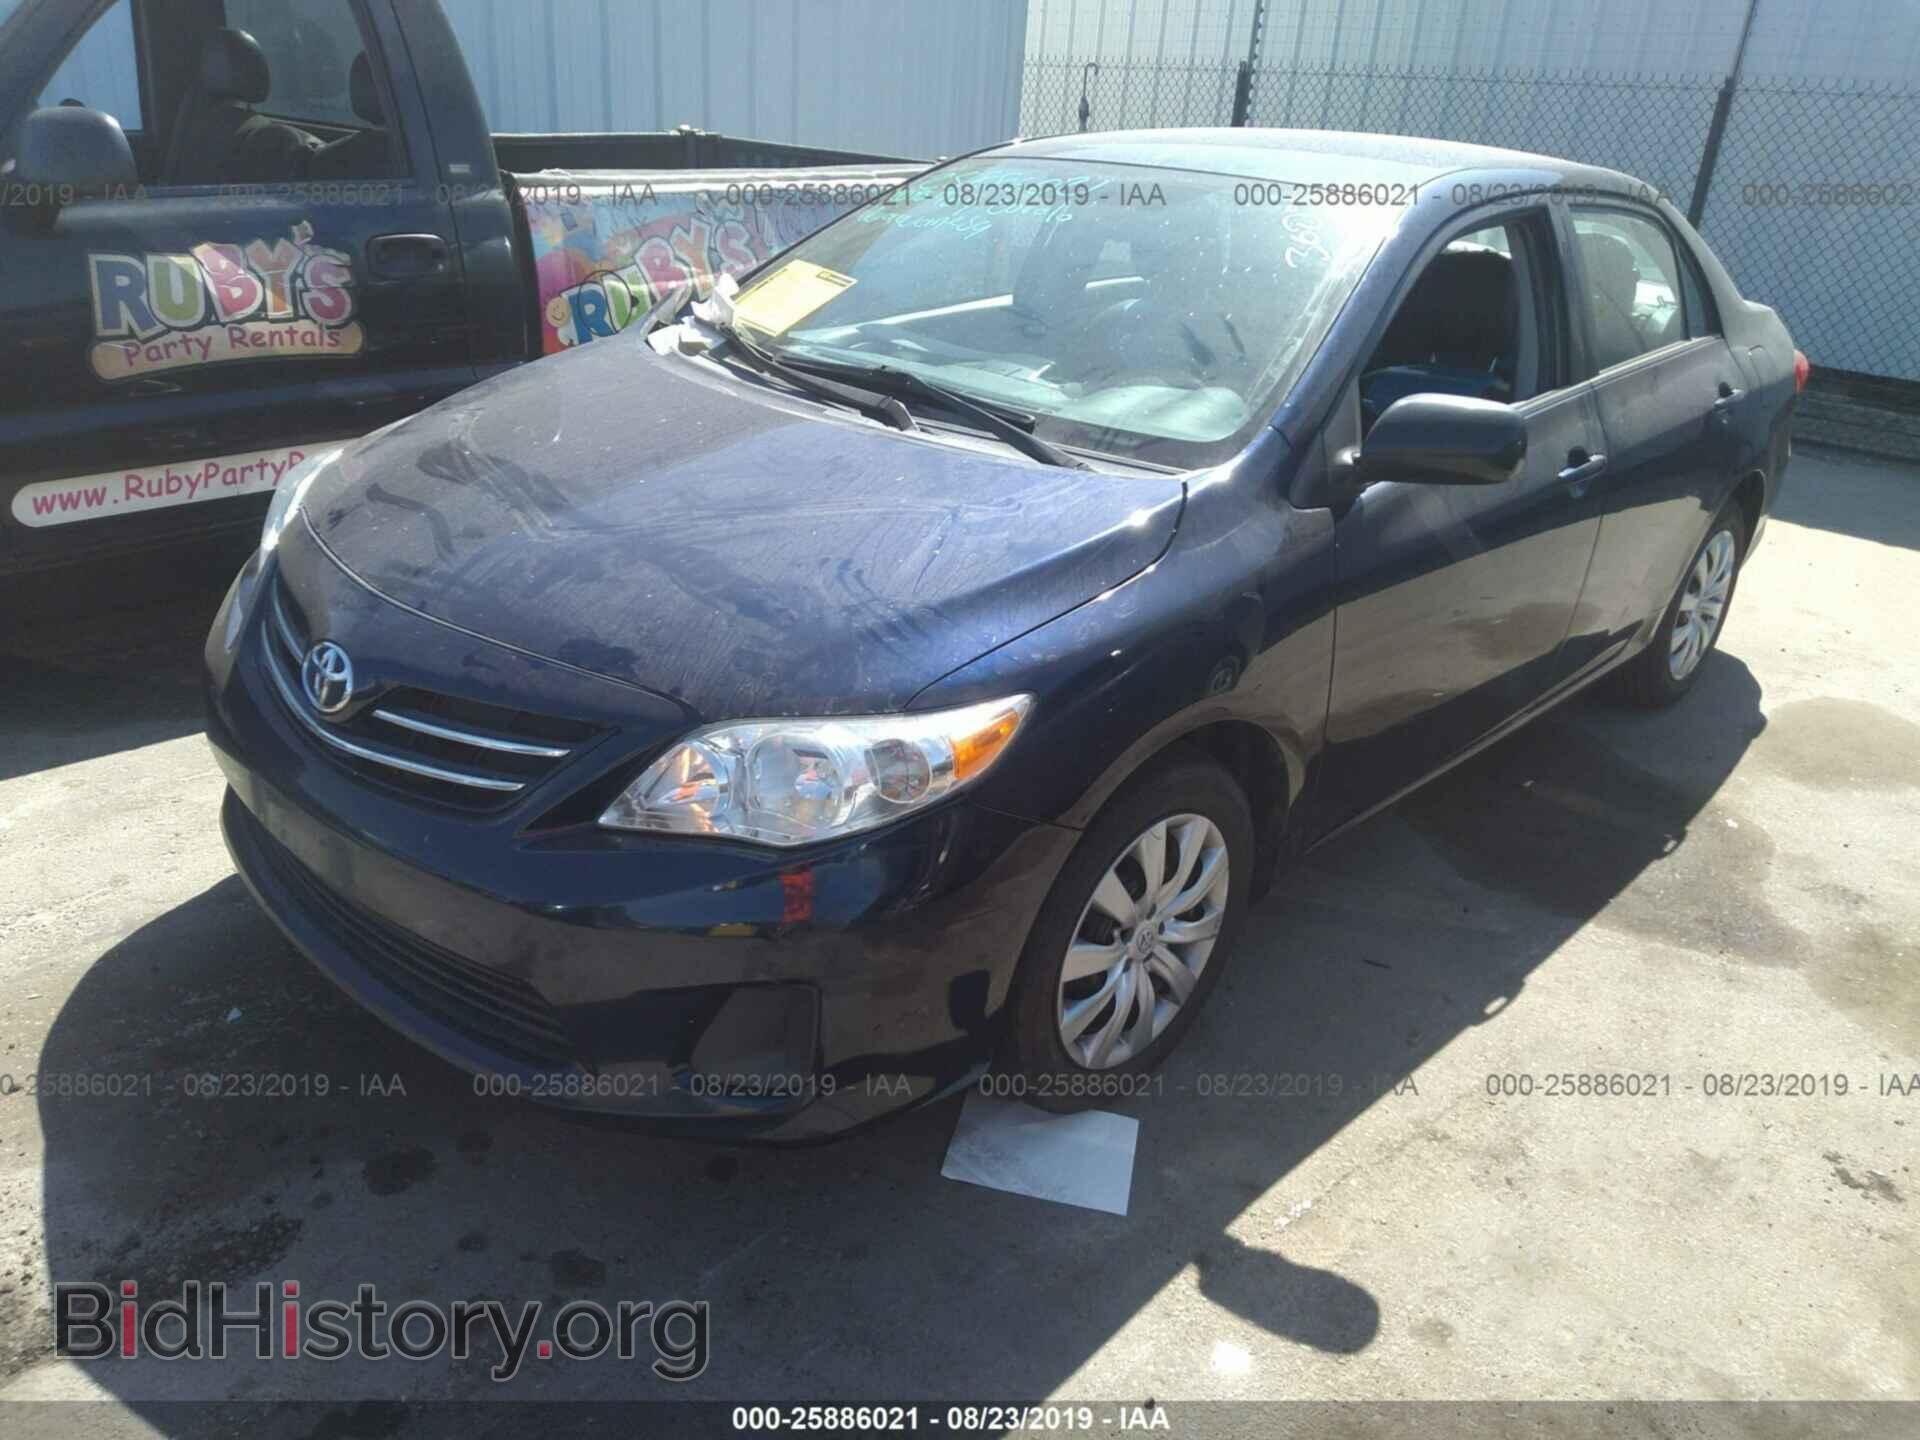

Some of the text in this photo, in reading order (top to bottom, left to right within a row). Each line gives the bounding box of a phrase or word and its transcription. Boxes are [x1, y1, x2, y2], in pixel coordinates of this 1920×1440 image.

[89, 220, 354, 340] RUBY'S
[123, 322, 343, 367] Party Rentals
